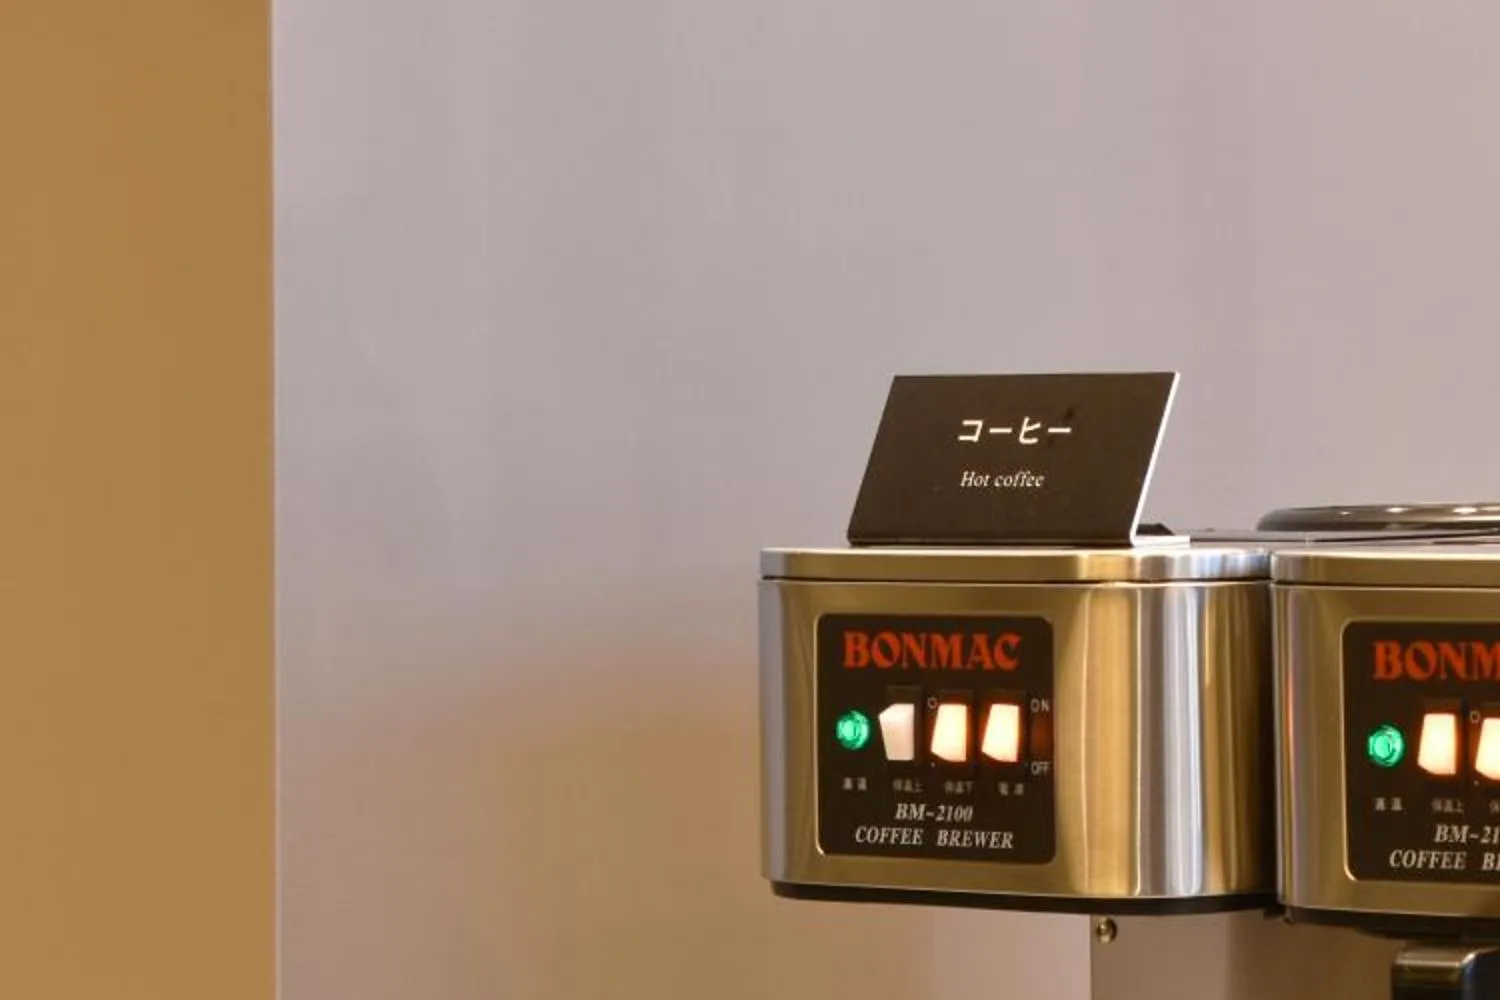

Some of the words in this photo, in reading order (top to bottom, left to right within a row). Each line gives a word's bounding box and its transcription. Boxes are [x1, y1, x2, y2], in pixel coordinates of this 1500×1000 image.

[958, 416, 1071, 444] コーヒー
[960, 471, 990, 487] Hot
[994, 471, 1045, 488] coffee
[843, 632, 1023, 671] BONMAC
[1031, 699, 1050, 712] ON
[1031, 762, 1050, 775] OFF
[895, 803, 973, 821] BM-2100
[855, 826, 924, 845] COFFEE
[937, 831, 1013, 849] BREWER
[1389, 850, 1467, 869] COFFEE
